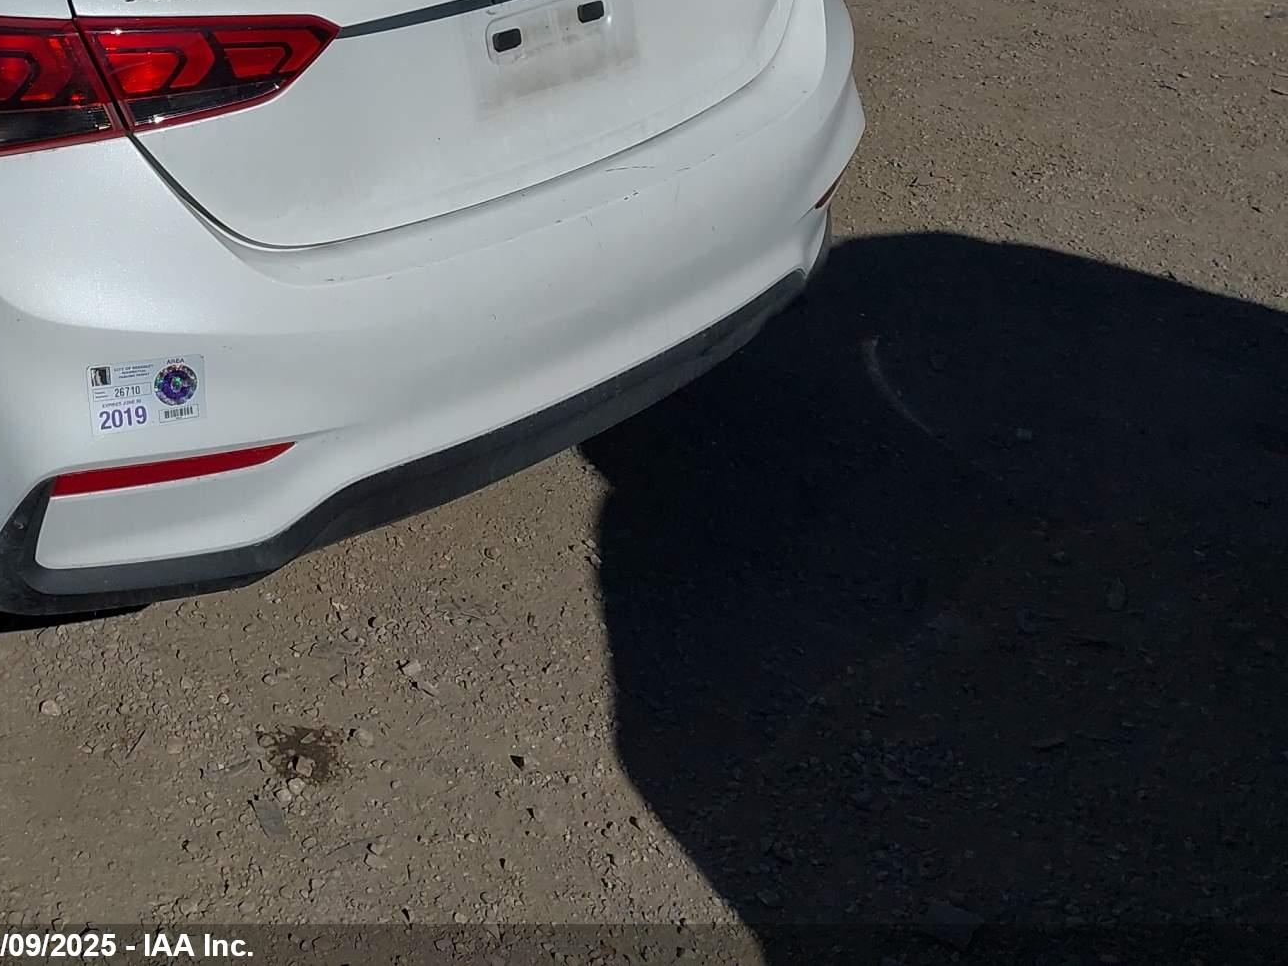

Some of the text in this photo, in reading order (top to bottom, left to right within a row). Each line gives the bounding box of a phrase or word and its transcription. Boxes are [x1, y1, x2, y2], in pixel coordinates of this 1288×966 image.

[166, 357, 185, 365] AREA
[114, 386, 141, 398] 26710
[99, 405, 147, 430] 2019
